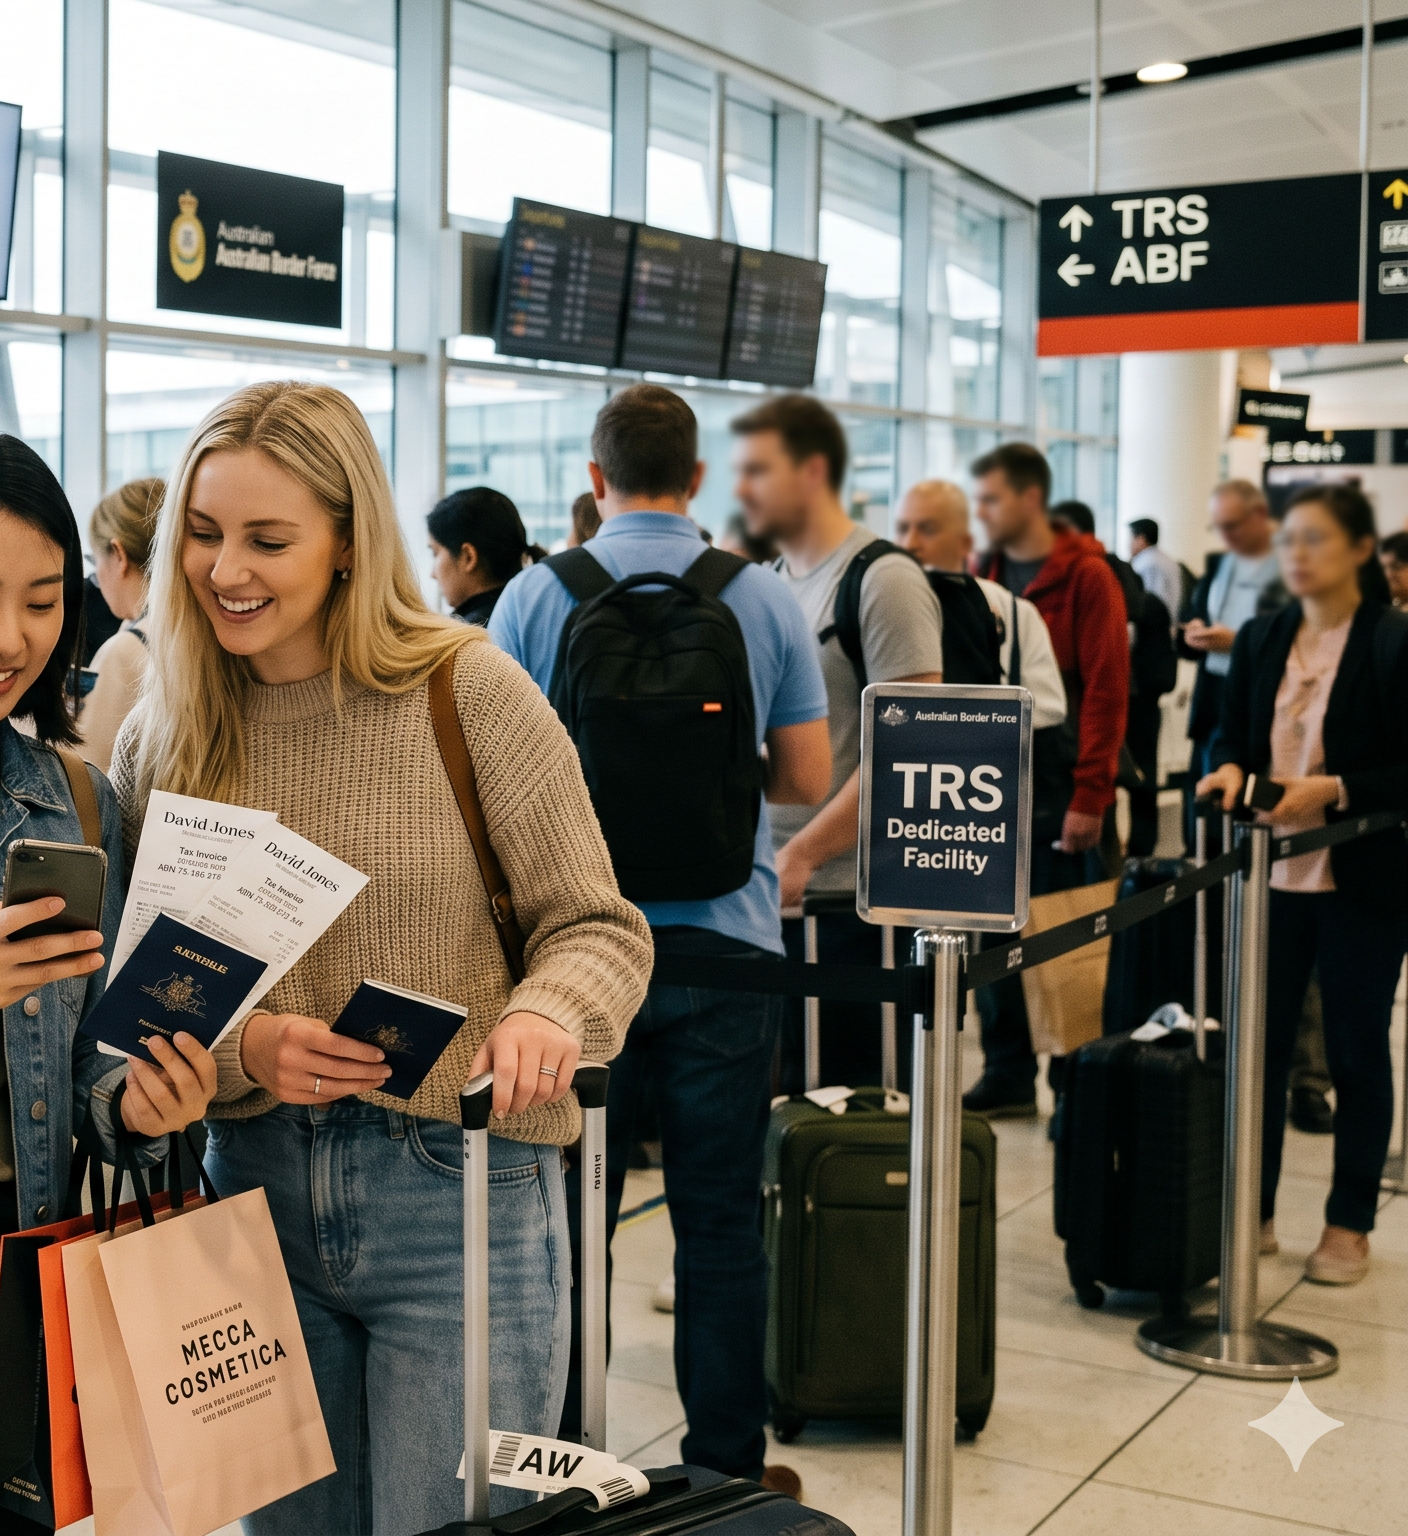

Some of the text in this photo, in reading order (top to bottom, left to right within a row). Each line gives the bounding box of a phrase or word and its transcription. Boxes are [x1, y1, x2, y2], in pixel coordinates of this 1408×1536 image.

[1111, 194, 1210, 240] TRS
[1110, 241, 1210, 286] ABF
[915, 710, 1017, 724] Australian Border Force
[893, 763, 1003, 812] TRS
[164, 811, 208, 831] David
[210, 821, 256, 840] Jones
[887, 818, 1006, 843] Dedicated
[179, 846, 228, 862] Tax Invoice
[264, 842, 305, 870] David
[302, 866, 340, 893] Jones
[904, 847, 989, 876] Facility
[181, 1318, 256, 1366] MECCA
[165, 1338, 287, 1405] COSMETICA
[517, 1447, 584, 1479] AW
